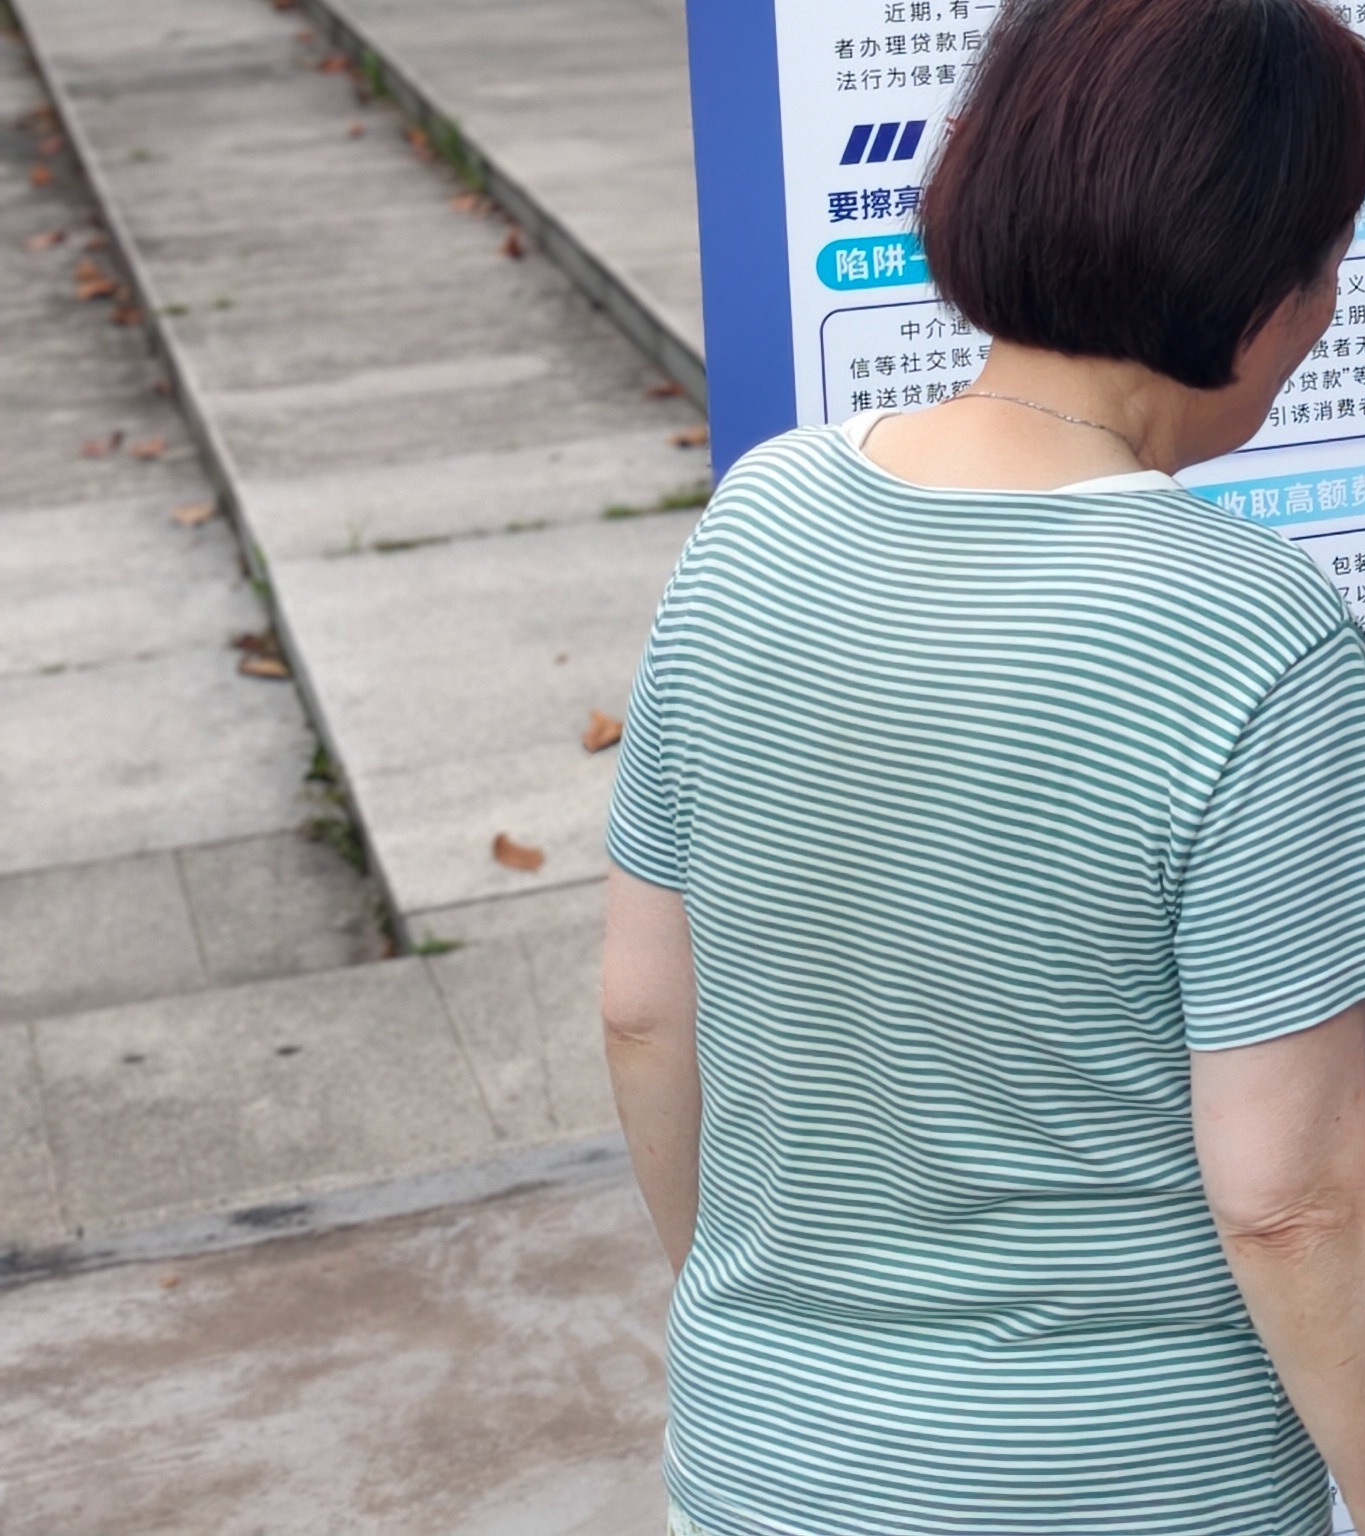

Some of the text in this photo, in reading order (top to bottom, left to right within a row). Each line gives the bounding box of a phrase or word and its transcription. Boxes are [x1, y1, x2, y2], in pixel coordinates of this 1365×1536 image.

[834, 29, 982, 60] 者办理贷款后
